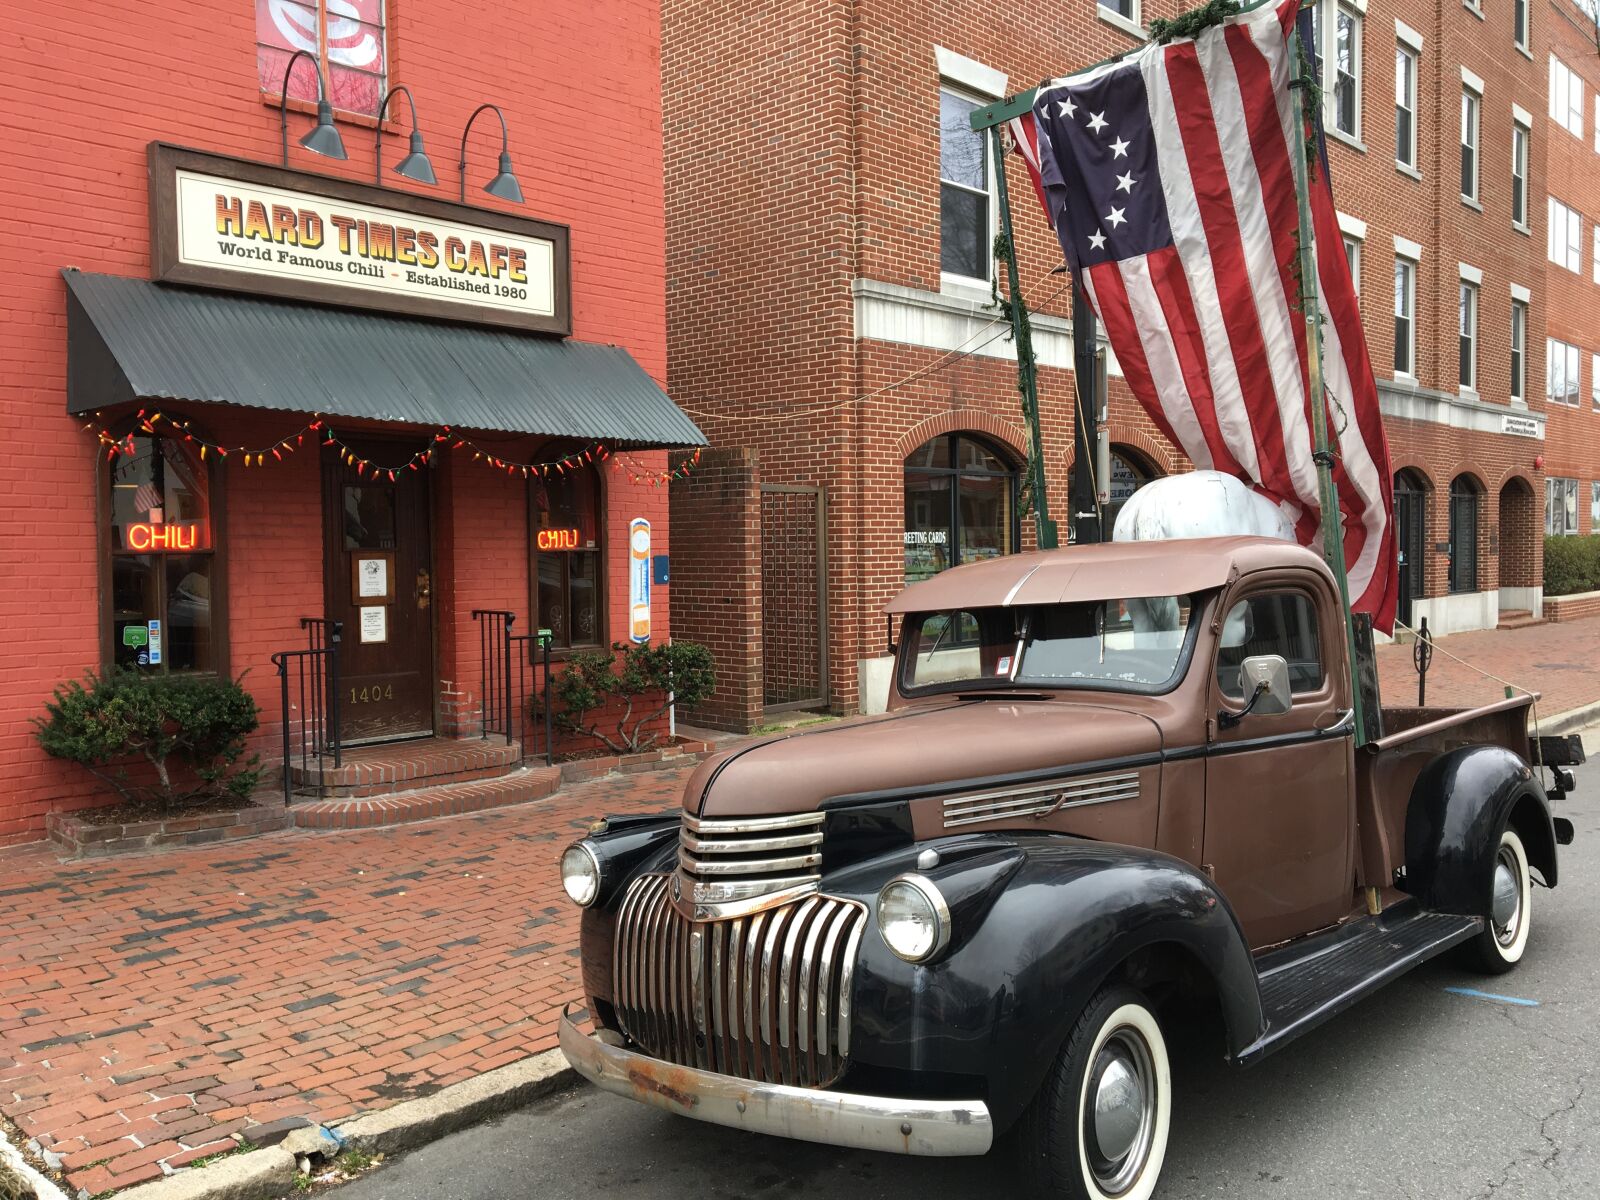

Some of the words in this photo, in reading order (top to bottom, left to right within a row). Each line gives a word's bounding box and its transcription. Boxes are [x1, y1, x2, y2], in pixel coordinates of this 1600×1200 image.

[215, 194, 324, 250] HARD
[330, 214, 439, 269] TIMES
[445, 236, 527, 284] CAFE
[217, 241, 272, 262] World
[277, 250, 343, 272] Famous
[348, 261, 385, 278] Chili
[406, 270, 490, 295] Established
[494, 284, 527, 300] 1980
[129, 524, 195, 549] CHILI
[537, 529, 577, 549] CHILI
[928, 531, 947, 544] CARDS
[350, 684, 393, 704] 1404
